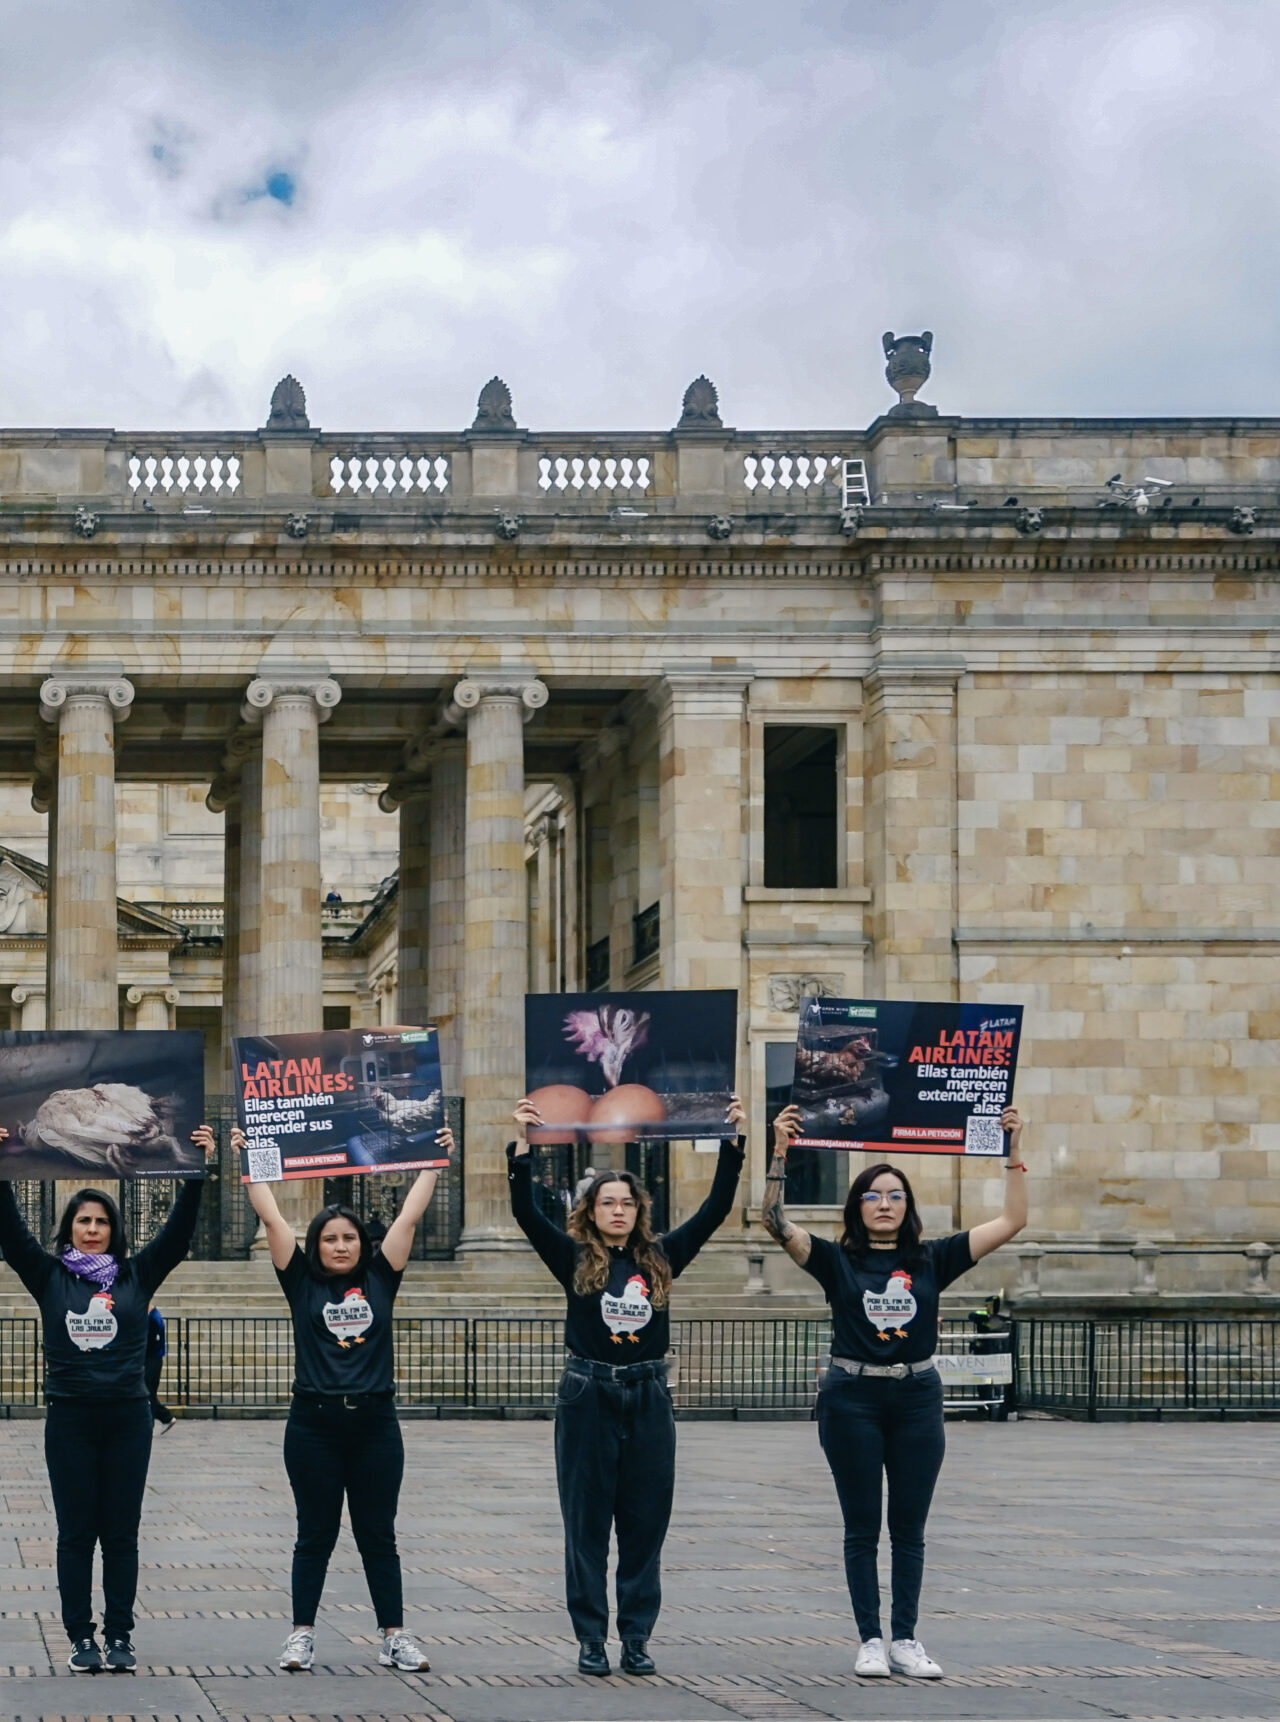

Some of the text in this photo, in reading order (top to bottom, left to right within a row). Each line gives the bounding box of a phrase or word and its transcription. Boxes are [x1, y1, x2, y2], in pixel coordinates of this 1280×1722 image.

[989, 1018, 1016, 1028] LATAM
[940, 1030, 1013, 1048] LATAM
[908, 1047, 1011, 1065] AIRLINES:
[242, 1057, 321, 1081] LATAM
[917, 1064, 1008, 1080] Ellas también
[243, 1073, 354, 1099] AIRLINES:
[947, 1079, 1006, 1091] merecen
[244, 1092, 334, 1112] Ellas también
[918, 1089, 1006, 1103] extender sus
[973, 1101, 1003, 1114] alas.
[246, 1109, 305, 1124] merecen
[246, 1119, 333, 1136] extender sus
[894, 1129, 915, 1137] FIRMA
[927, 1129, 961, 1138] PETICIÓN
[247, 1135, 278, 1149] alas.
[285, 1158, 305, 1167] FIRMA
